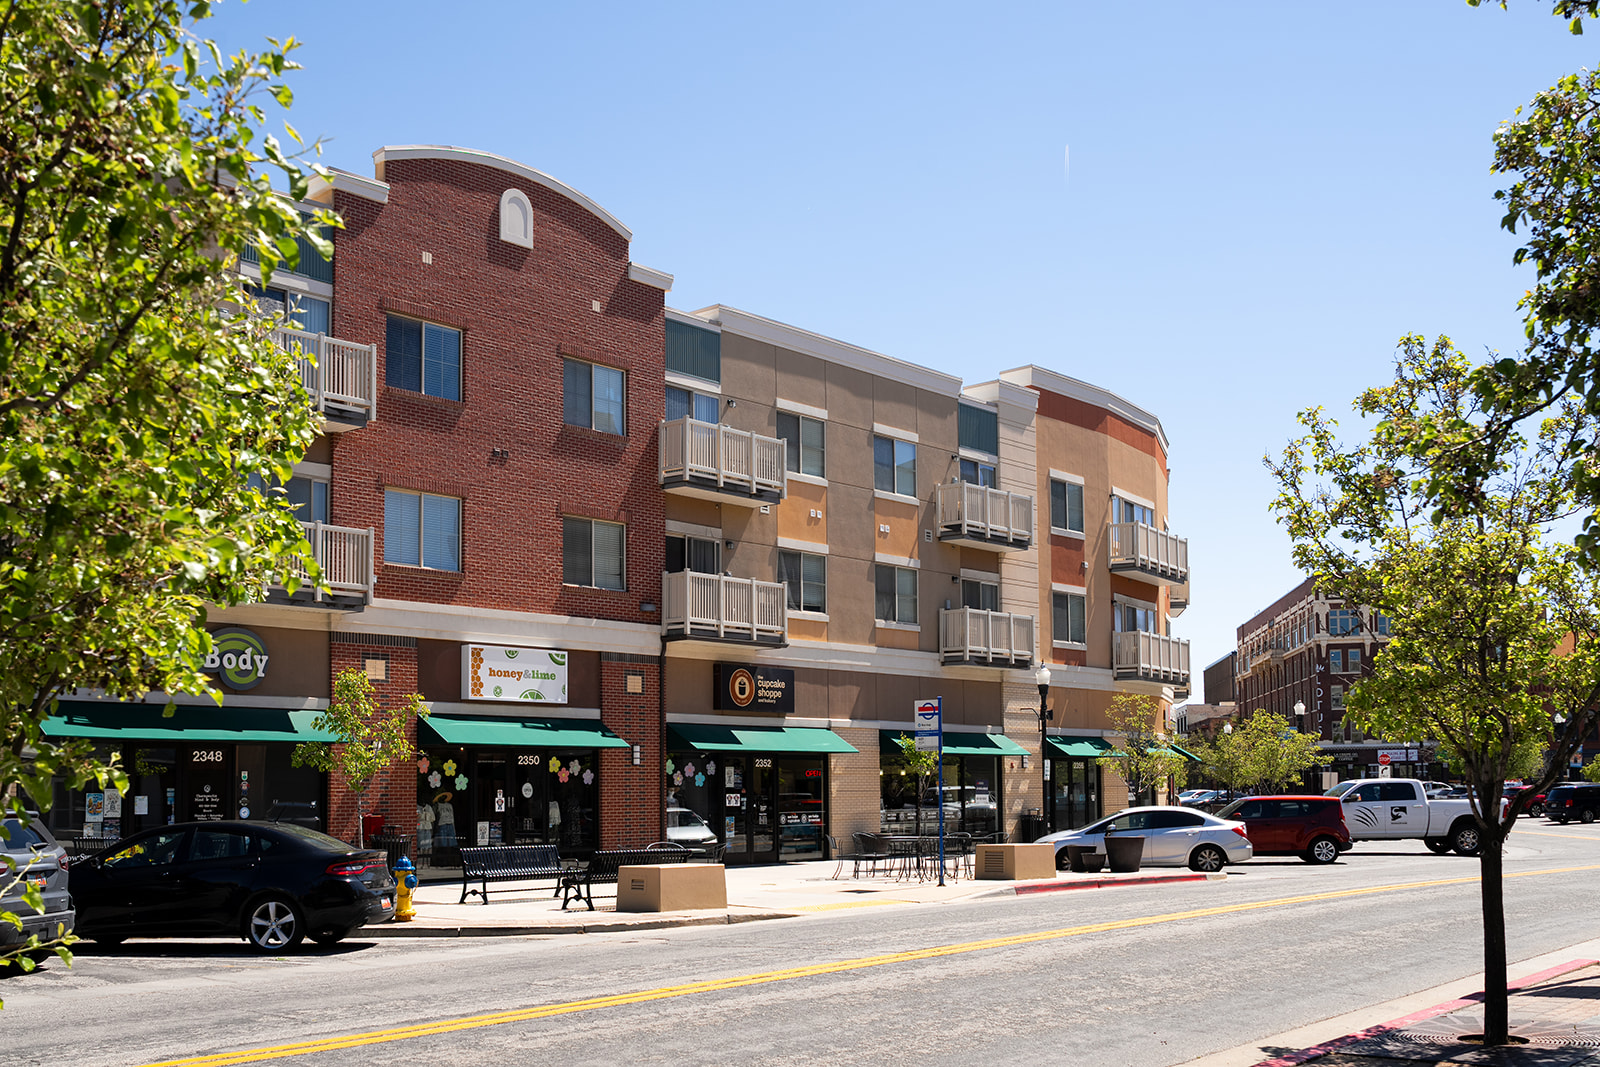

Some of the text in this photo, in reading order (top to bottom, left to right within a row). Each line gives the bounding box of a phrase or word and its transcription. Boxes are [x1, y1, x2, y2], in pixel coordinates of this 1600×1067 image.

[204, 645, 269, 677] Body
[757, 679, 786, 689] cupcake
[757, 688, 783, 699] shoppe
[192, 750, 223, 762] 2348
[517, 755, 540, 765] 2350
[755, 758, 772, 768] 2352
[805, 769, 822, 777] OPEN
